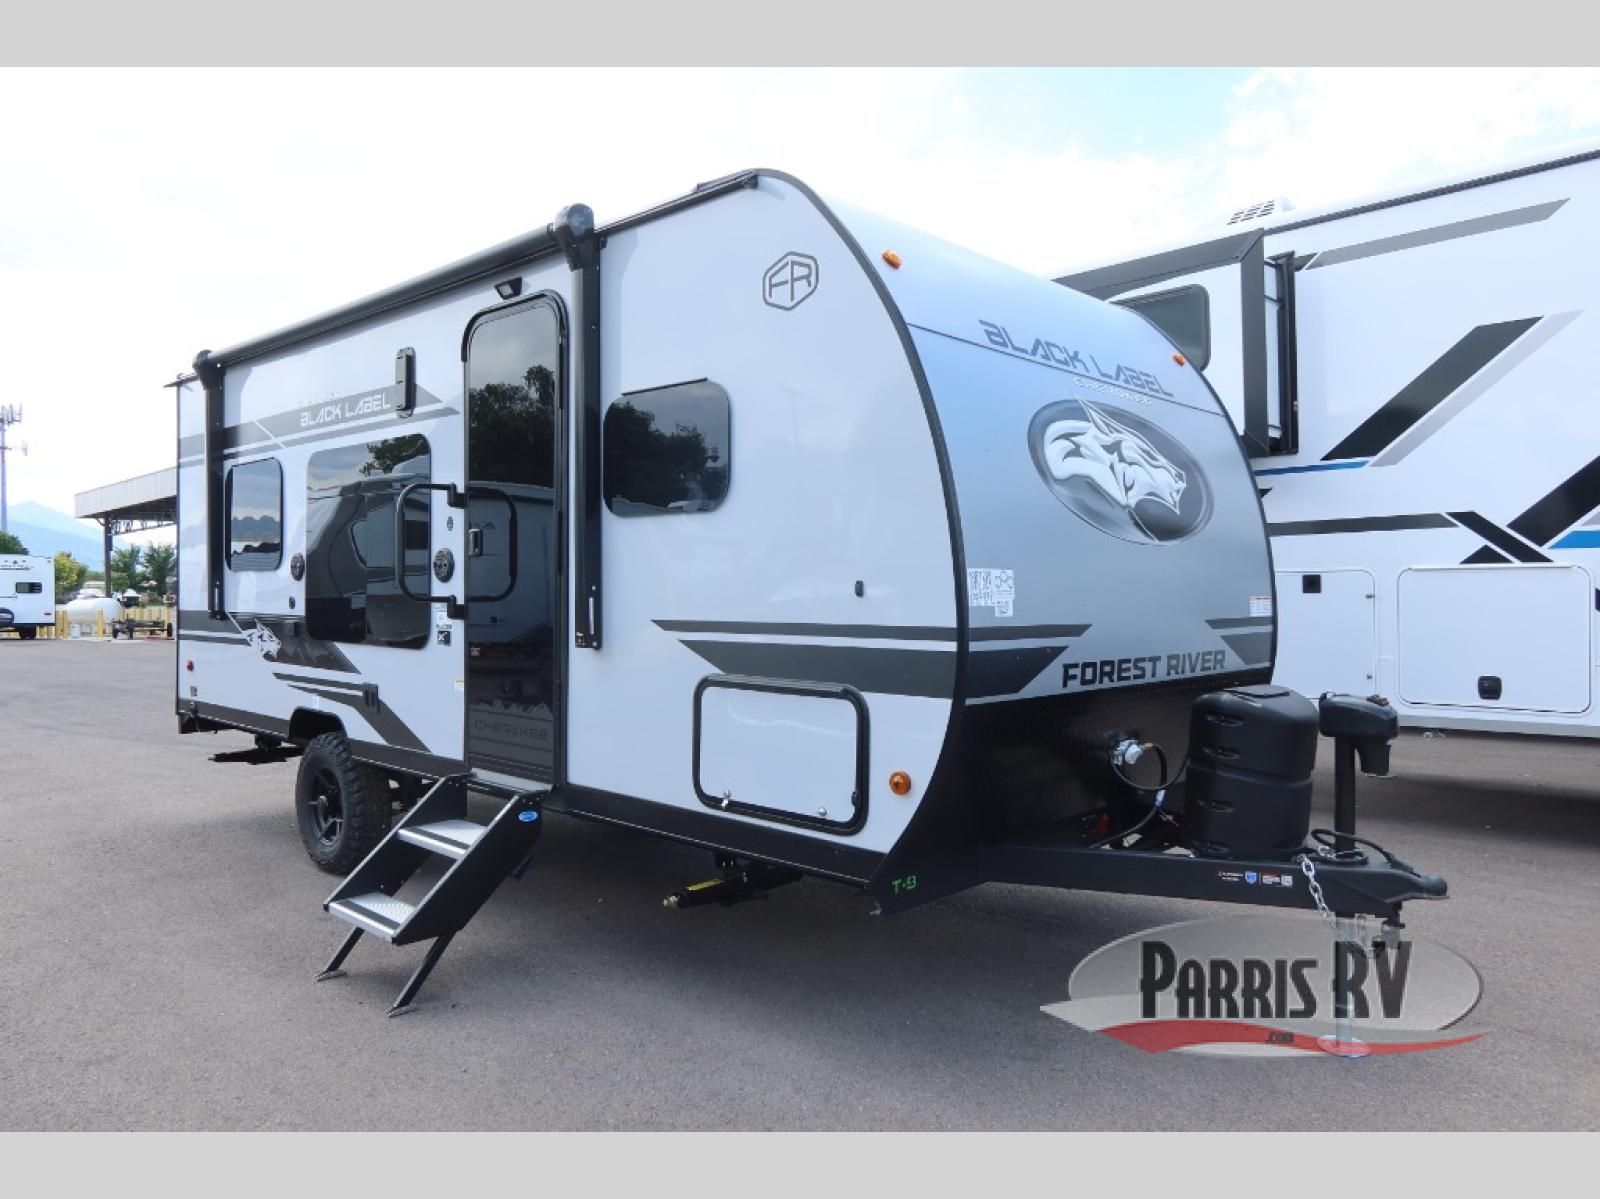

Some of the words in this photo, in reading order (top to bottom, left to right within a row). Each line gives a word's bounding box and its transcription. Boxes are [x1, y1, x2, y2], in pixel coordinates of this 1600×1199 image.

[977, 318, 1091, 374] BLACK
[1089, 354, 1175, 398] LABEL
[300, 403, 342, 427] BLACK
[345, 391, 392, 418] LABEL
[1062, 655, 1162, 689] FOREST
[1166, 649, 1226, 677] RIVER
